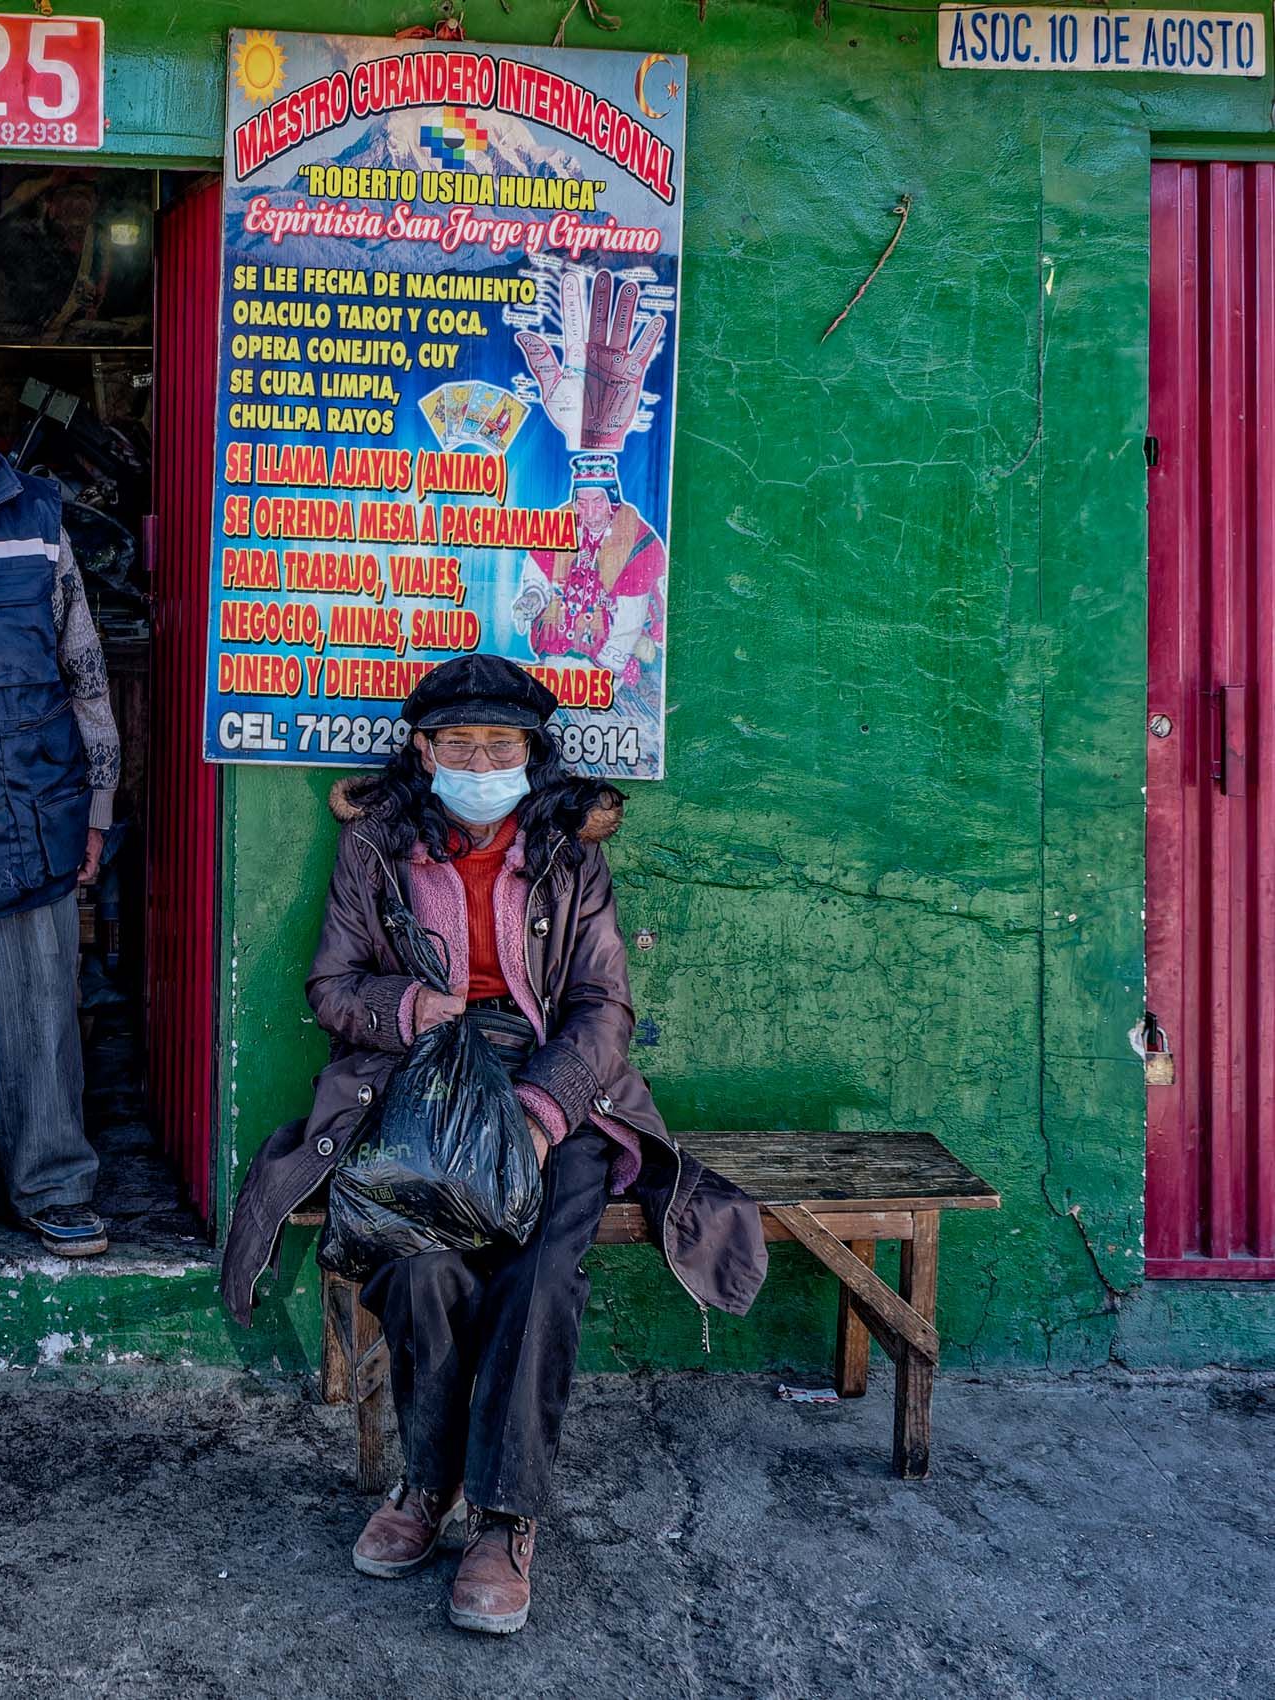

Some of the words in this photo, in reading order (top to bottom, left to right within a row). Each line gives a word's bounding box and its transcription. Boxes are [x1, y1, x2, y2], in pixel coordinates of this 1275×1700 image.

[949, 12, 1040, 63] ASOC.
[1048, 14, 1078, 63] 10
[1094, 16, 1130, 65] DE
[1142, 17, 1254, 70] AGOSTO
[235, 72, 349, 181] MAESTRO
[351, 53, 495, 114] CURANDERO
[499, 60, 674, 204] INTERNACIONAL
[422, 171, 494, 204] USIDA
[245, 198, 384, 244] Espiritista
[386, 206, 440, 241] San
[440, 207, 522, 252] Jorge
[524, 222, 546, 255] y
[548, 219, 660, 258] Cipriano
[233, 266, 258, 290] SE
[264, 268, 297, 292] LEE
[303, 270, 367, 296] FECHA
[373, 273, 397, 297] DE
[405, 275, 537, 303] NACIMIENTO
[233, 301, 331, 329] ORACULO
[337, 305, 404, 332] TAROT
[405, 307, 420, 331] Y
[426, 310, 488, 336] COCA.
[232, 334, 302, 362] OPERA
[306, 336, 413, 370] CONEJITO,
[418, 342, 459, 367] CUY
[230, 368, 254, 393] SE
[259, 369, 316, 396] CURA
[322, 371, 400, 404] LIMPIA,
[229, 405, 322, 432] CHULLPA
[326, 408, 393, 434] RAYOS
[226, 443, 251, 483] SE
[256, 446, 327, 488] LLAMA
[331, 448, 411, 491] AJAYUS
[415, 450, 506, 504] (ANIMO)
[224, 496, 249, 538] SE
[254, 497, 353, 541] OFRENDA
[358, 500, 417, 543] MESA
[420, 503, 438, 543] A
[441, 504, 579, 550] PACHAMAMA
[222, 550, 279, 590] PARA
[283, 552, 386, 599] TRABAJO,
[389, 556, 466, 603] VIAJES,
[220, 601, 326, 649] NEGOCIO,
[329, 606, 406, 654] MINAS,
[411, 609, 479, 651] SALUD
[219, 655, 298, 696] DINERO
[302, 656, 323, 697] Y
[325, 660, 445, 702] DIFERENT
[521, 666, 614, 708] EDADES
[219, 712, 288, 751] CEL:
